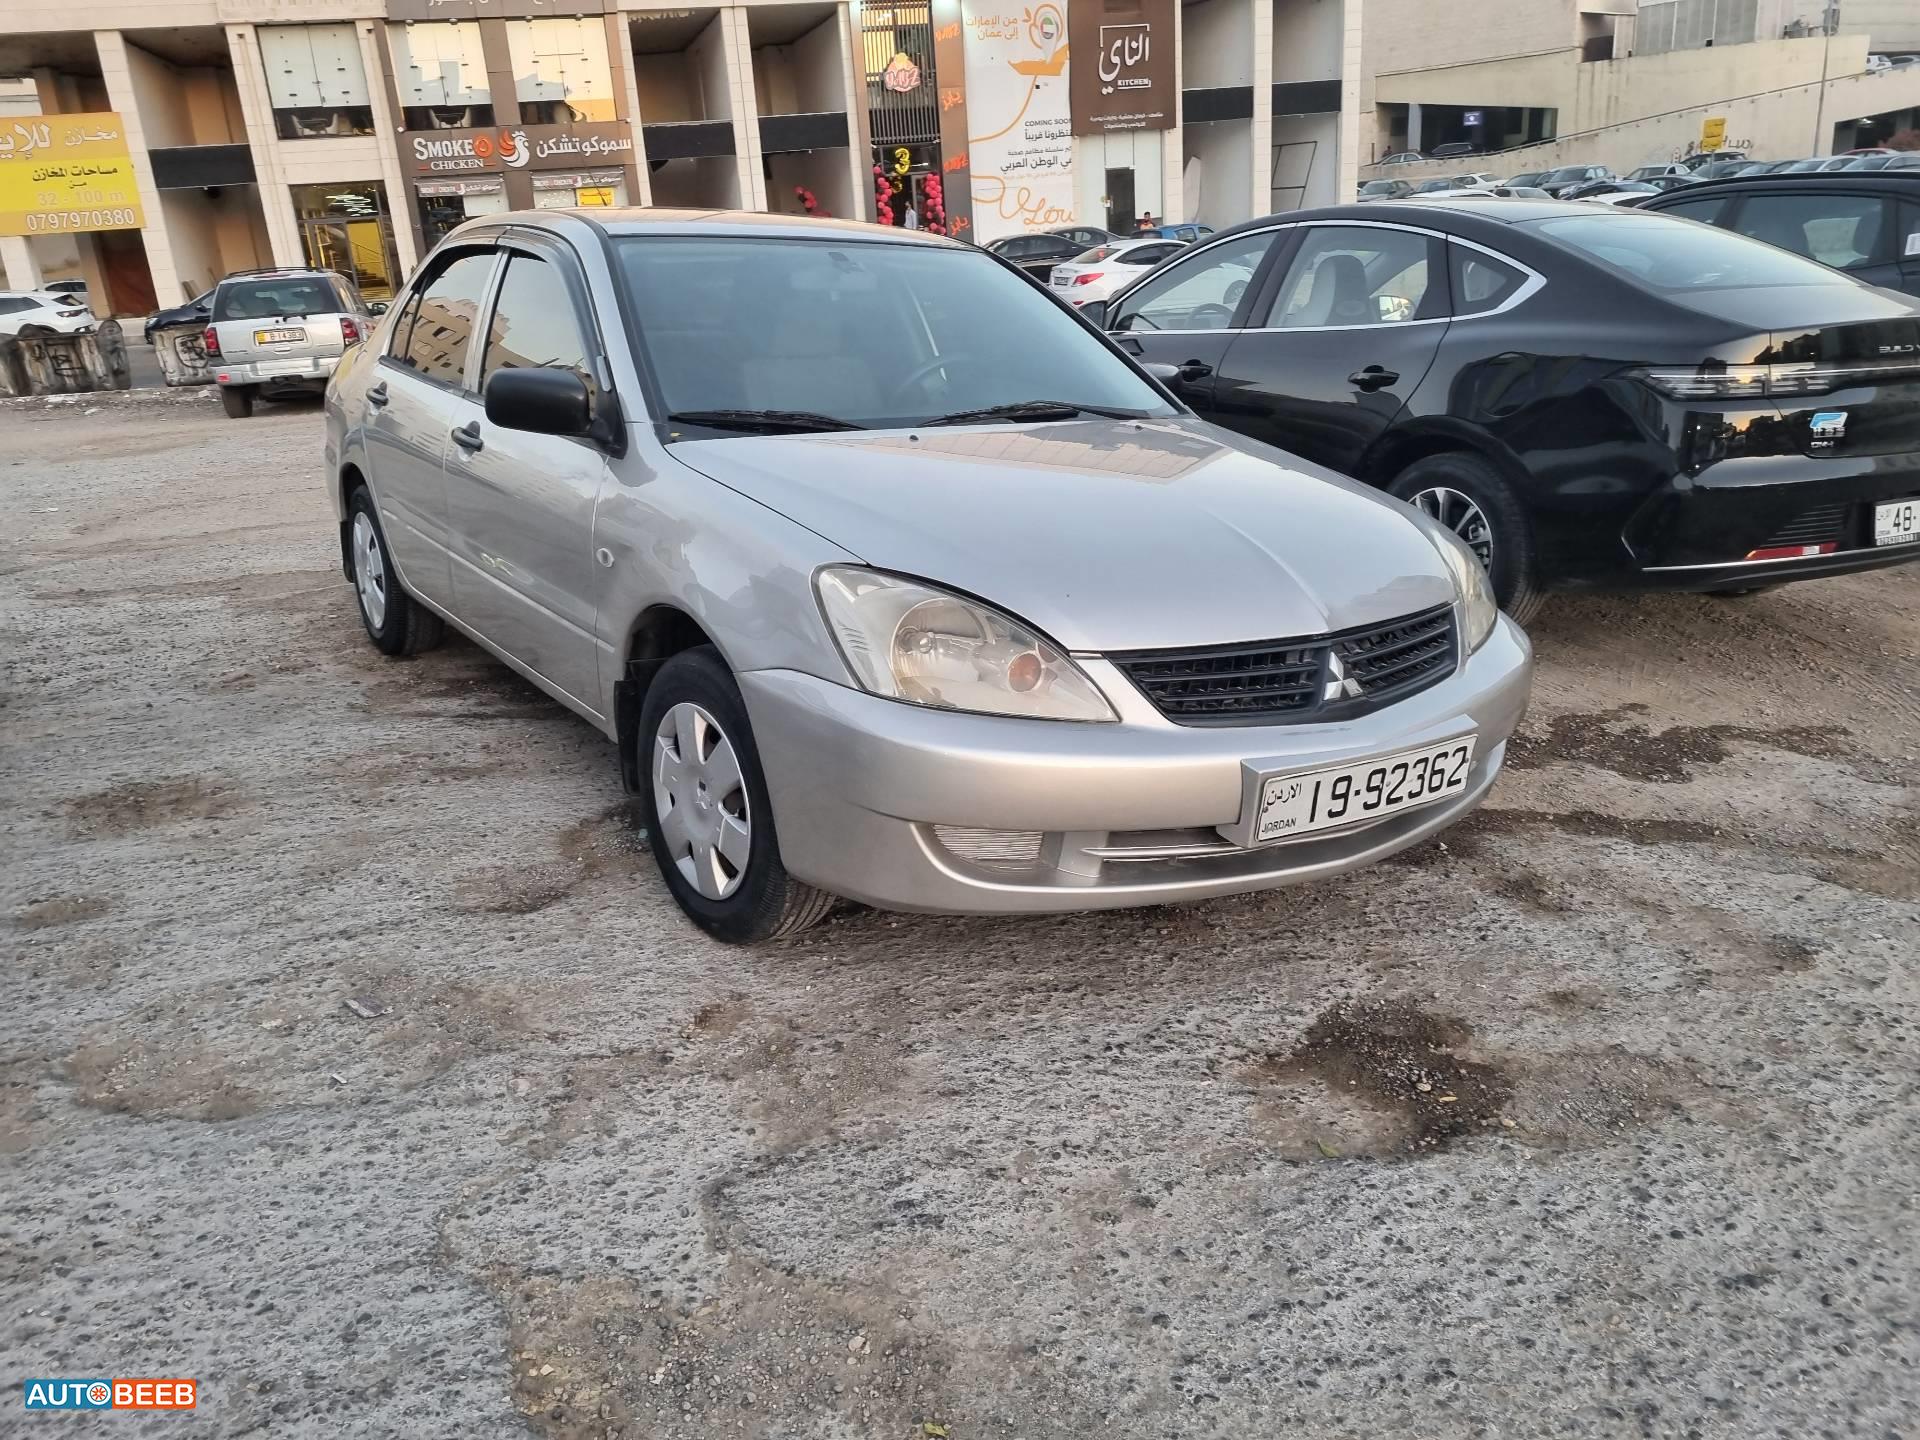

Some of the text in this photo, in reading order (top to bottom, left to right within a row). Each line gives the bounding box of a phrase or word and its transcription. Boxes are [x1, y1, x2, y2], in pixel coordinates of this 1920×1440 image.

[1003, 16, 1018, 26] من
[977, 28, 1002, 40] عمان
[1098, 33, 1150, 95] الناي
[1117, 78, 1149, 86] KITCHEN
[1024, 119, 1053, 127] COMING
[0, 121, 118, 160] مخازن للإي
[430, 158, 485, 171] CHICKEN
[1000, 158, 1028, 174] العربي
[1030, 155, 1058, 169] الوطن
[32, 164, 118, 182] مساحات المخازن
[68, 180, 87, 189] من
[38, 192, 57, 206] 32
[76, 191, 103, 203] 100
[110, 192, 125, 202] m
[26, 208, 136, 231] 0797970380
[1893, 506, 1917, 533] 48-
[1308, 746, 1468, 823] 19-92362
[1261, 818, 1297, 833] JORDAN
